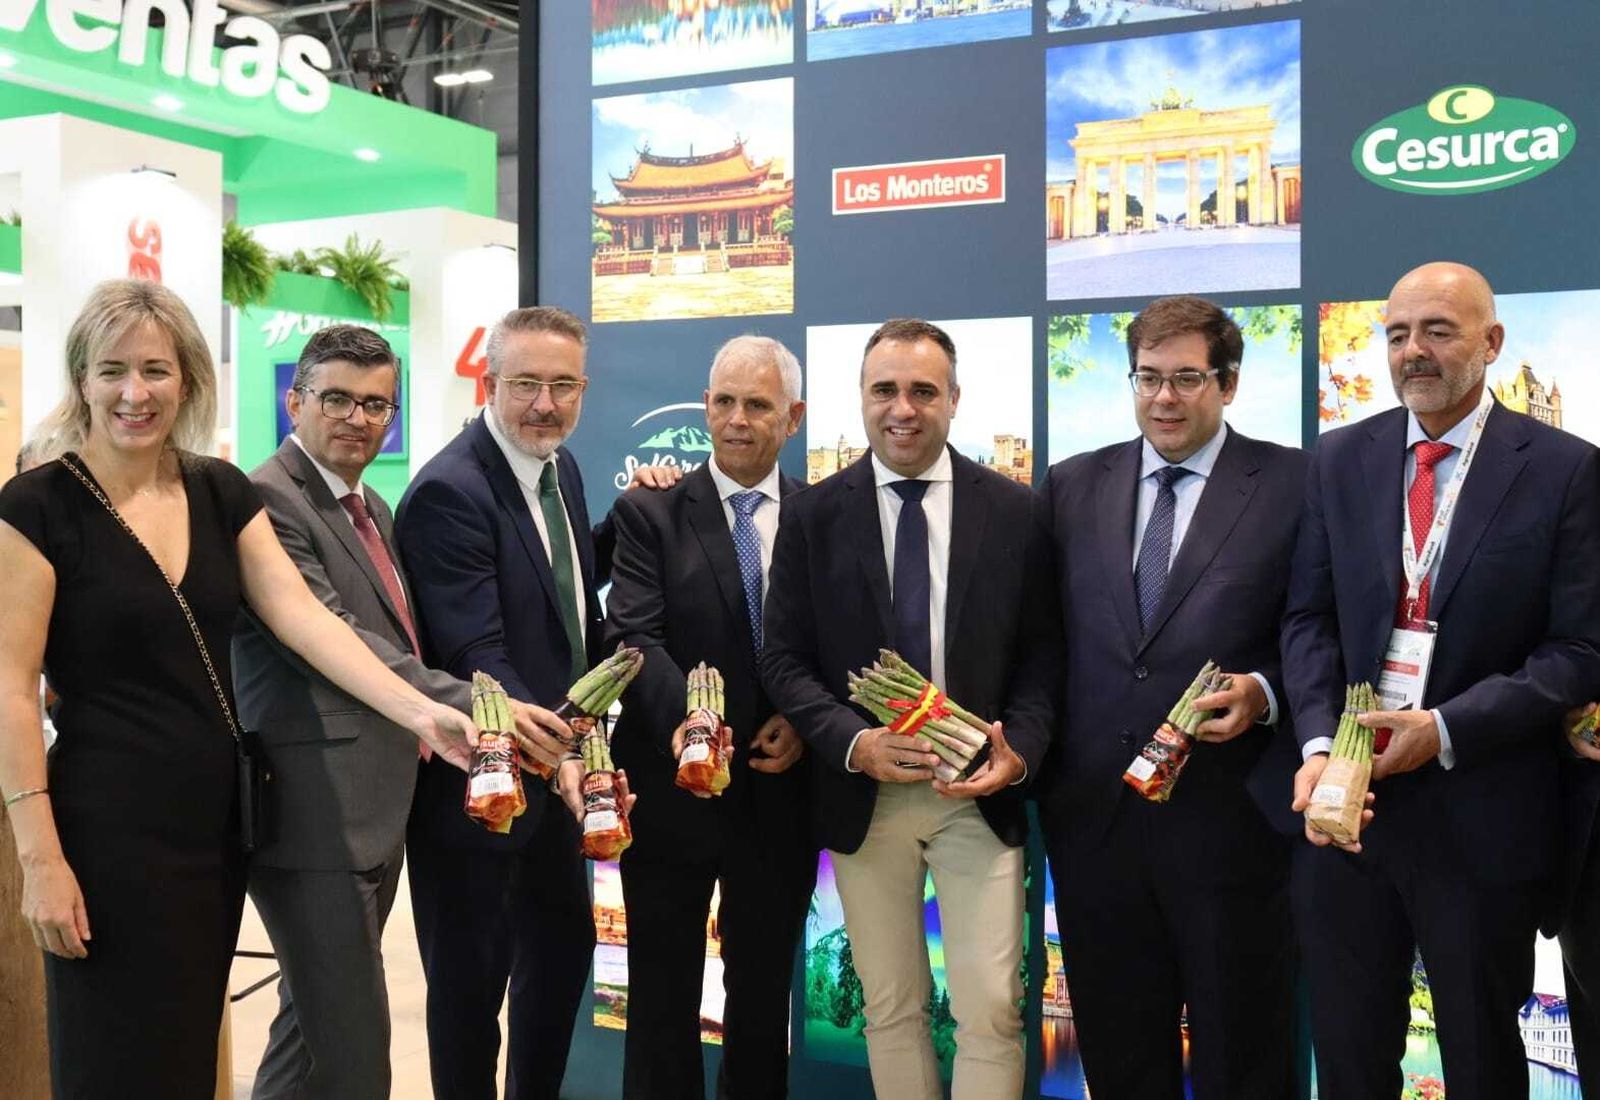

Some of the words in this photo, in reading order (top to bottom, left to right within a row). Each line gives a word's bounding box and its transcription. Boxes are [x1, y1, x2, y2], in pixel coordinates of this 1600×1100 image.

[1361, 125, 1560, 176] Cesurca
[843, 178, 881, 204] Los
[887, 172, 989, 201] Monteros
